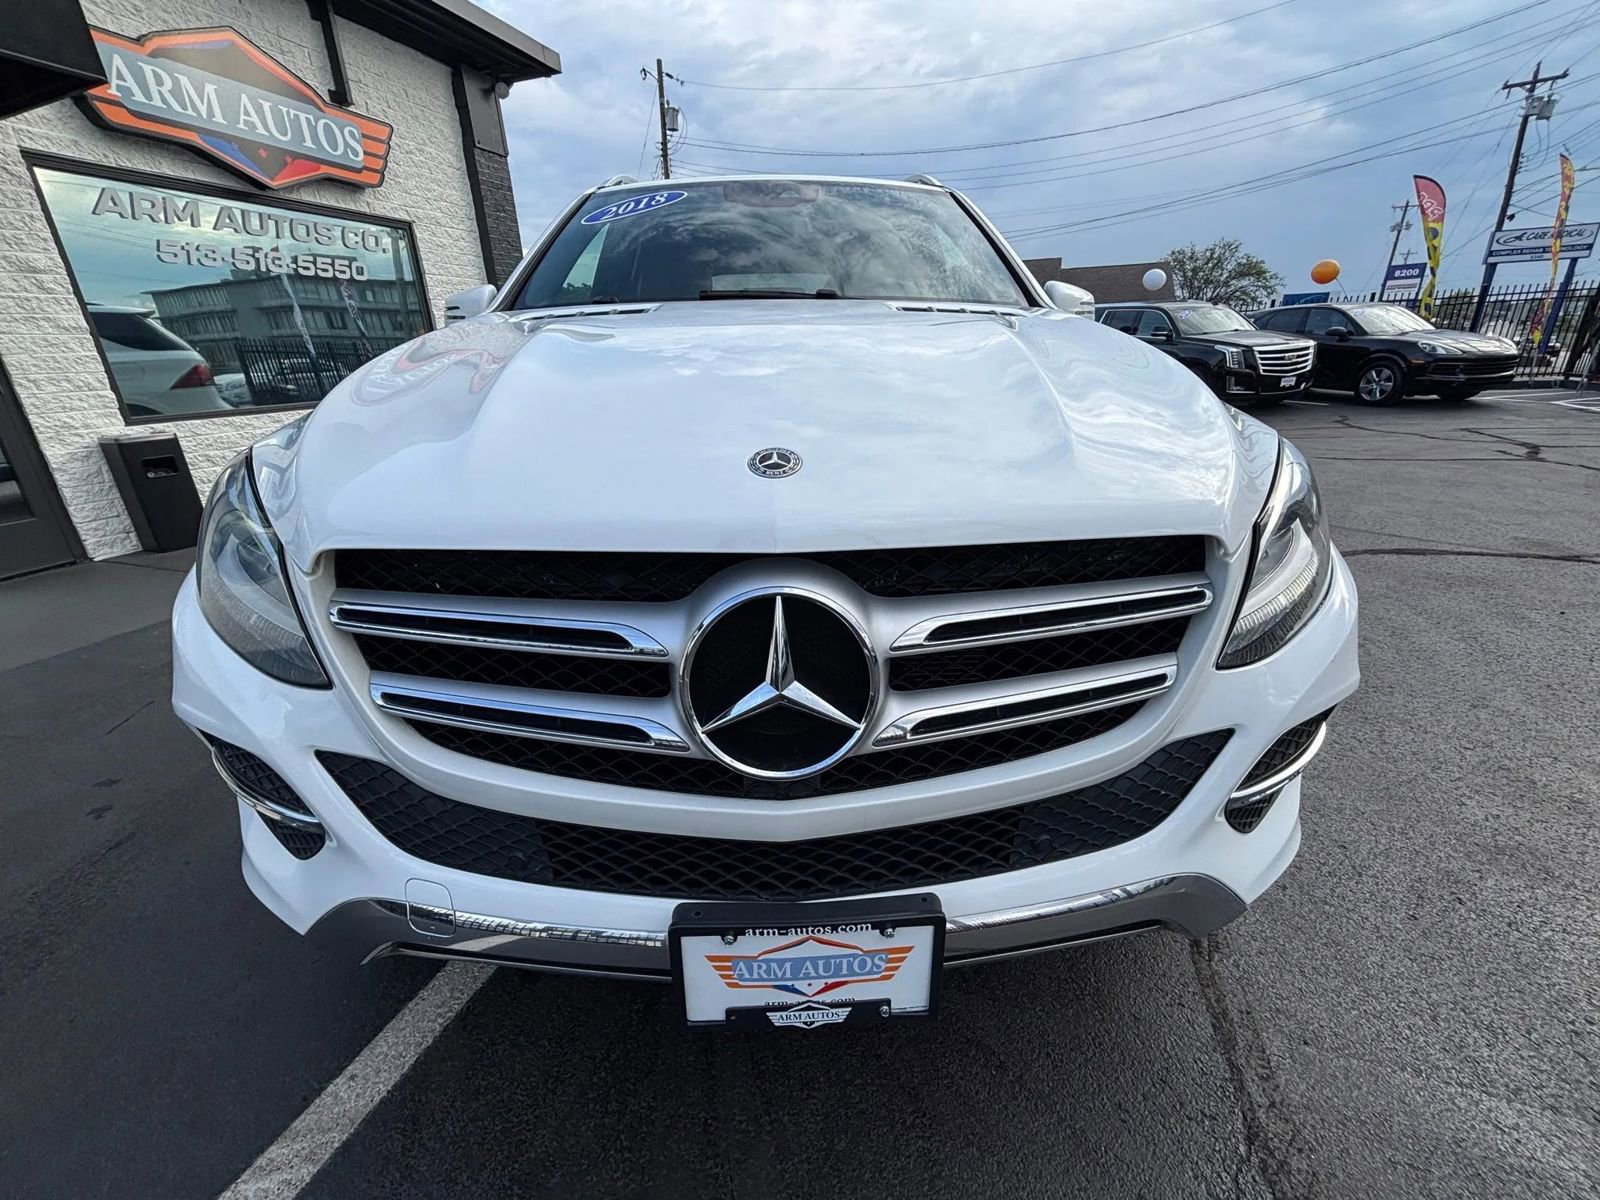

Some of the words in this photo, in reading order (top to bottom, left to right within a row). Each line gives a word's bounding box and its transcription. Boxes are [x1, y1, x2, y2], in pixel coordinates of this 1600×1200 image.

[107, 54, 228, 125] ARM
[236, 93, 365, 163] AUTOS
[601, 193, 668, 220] 2018
[92, 187, 201, 228] ARM
[213, 205, 335, 247] AUTOS
[341, 226, 391, 255] CO.
[155, 239, 369, 281] 513-513-5550
[1492, 248, 1521, 256] COMPLEX
[1394, 268, 1420, 277] 8200
[745, 922, 872, 937] arm-autos.com
[734, 961, 793, 979] ARM
[799, 954, 888, 978] AUTOS
[778, 1011, 802, 1021] ARM
[804, 1010, 841, 1020] AUTOS
